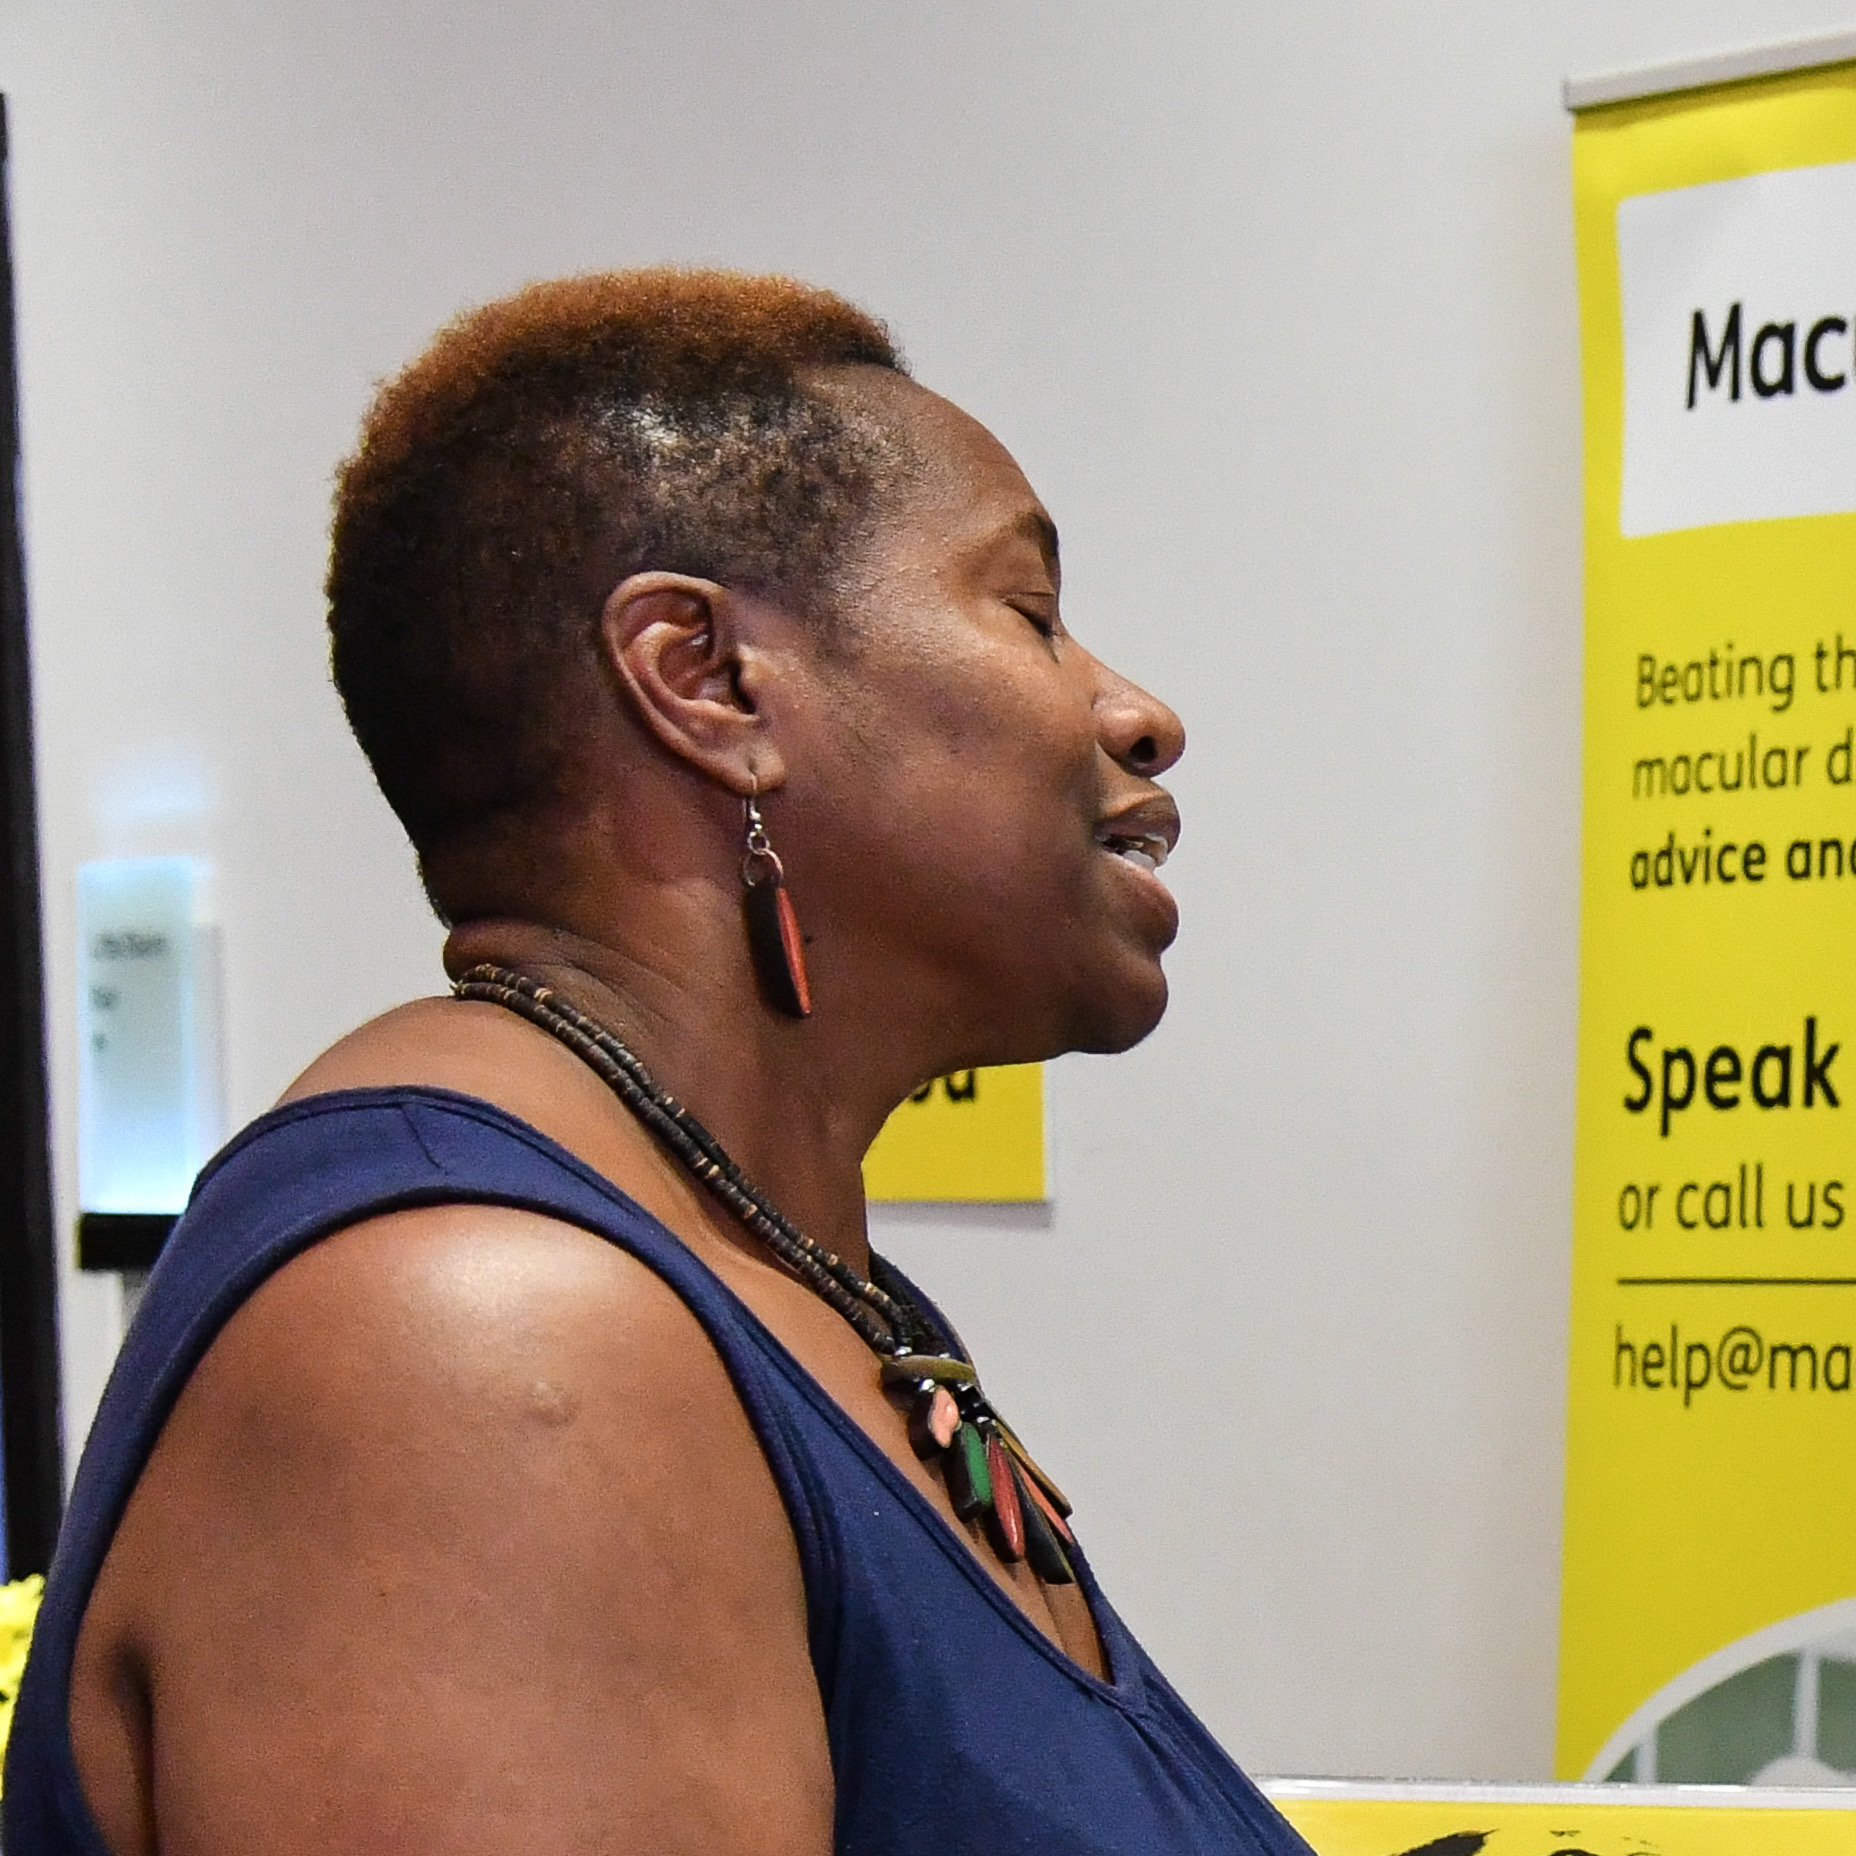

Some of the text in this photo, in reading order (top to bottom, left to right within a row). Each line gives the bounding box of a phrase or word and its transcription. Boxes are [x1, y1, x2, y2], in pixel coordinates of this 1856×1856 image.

[1635, 641, 1796, 714] Beating
[1632, 732, 1811, 798] macular
[1629, 830, 1768, 892] advice
[1622, 1014, 1841, 1139] Speak
[1618, 1183, 1662, 1232] or
[1675, 1162, 1765, 1231] call
[1785, 1179, 1846, 1231] us
